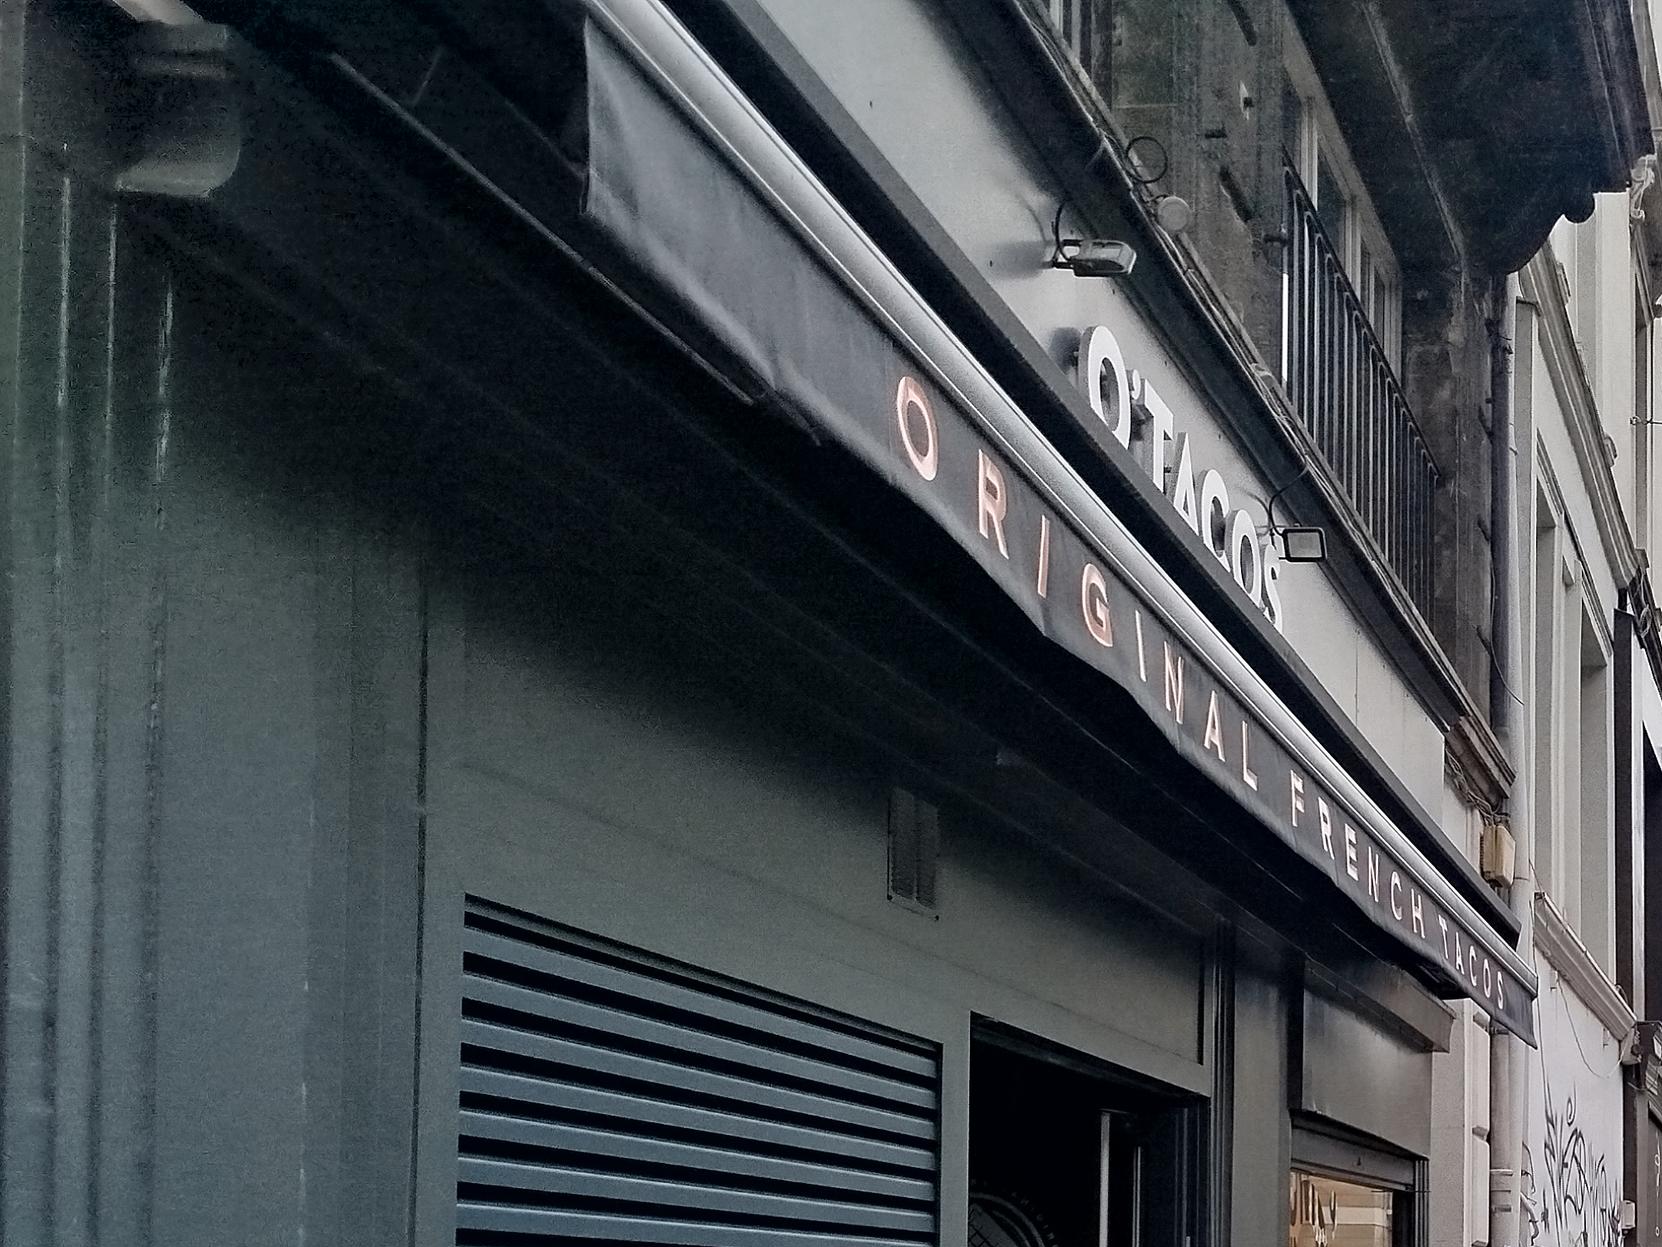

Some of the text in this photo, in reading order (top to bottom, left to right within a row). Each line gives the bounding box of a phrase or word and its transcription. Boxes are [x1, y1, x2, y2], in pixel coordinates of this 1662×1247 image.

[897, 376, 1506, 1010] ORIGINAL FRENCH TACOS
[1082, 326, 1283, 629] O'TACOS
